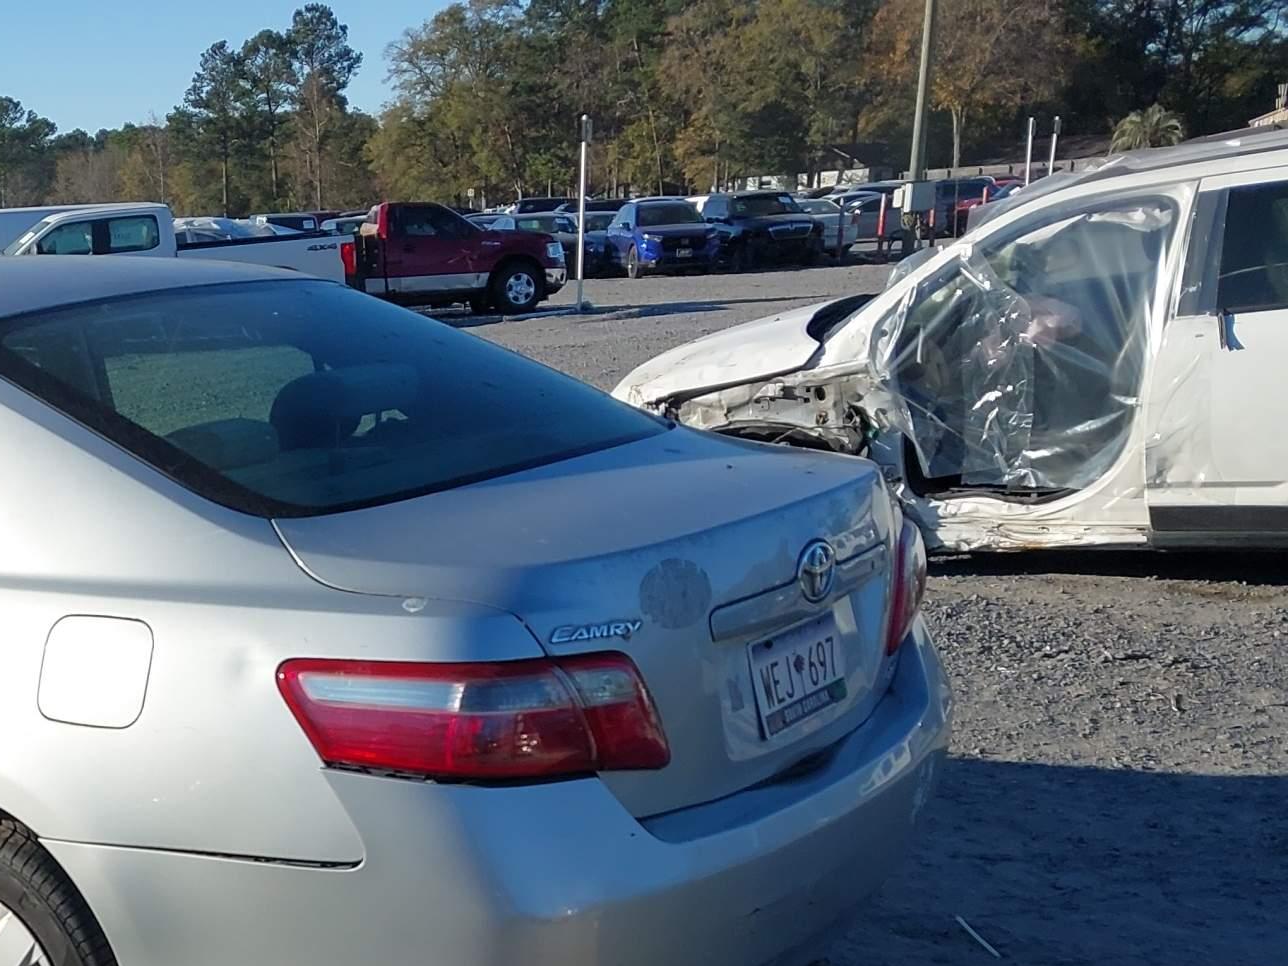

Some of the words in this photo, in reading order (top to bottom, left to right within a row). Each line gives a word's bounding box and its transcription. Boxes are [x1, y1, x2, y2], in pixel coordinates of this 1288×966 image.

[550, 620, 642, 644] CAMRY
[760, 655, 795, 710] WEJ
[808, 636, 837, 687] 697
